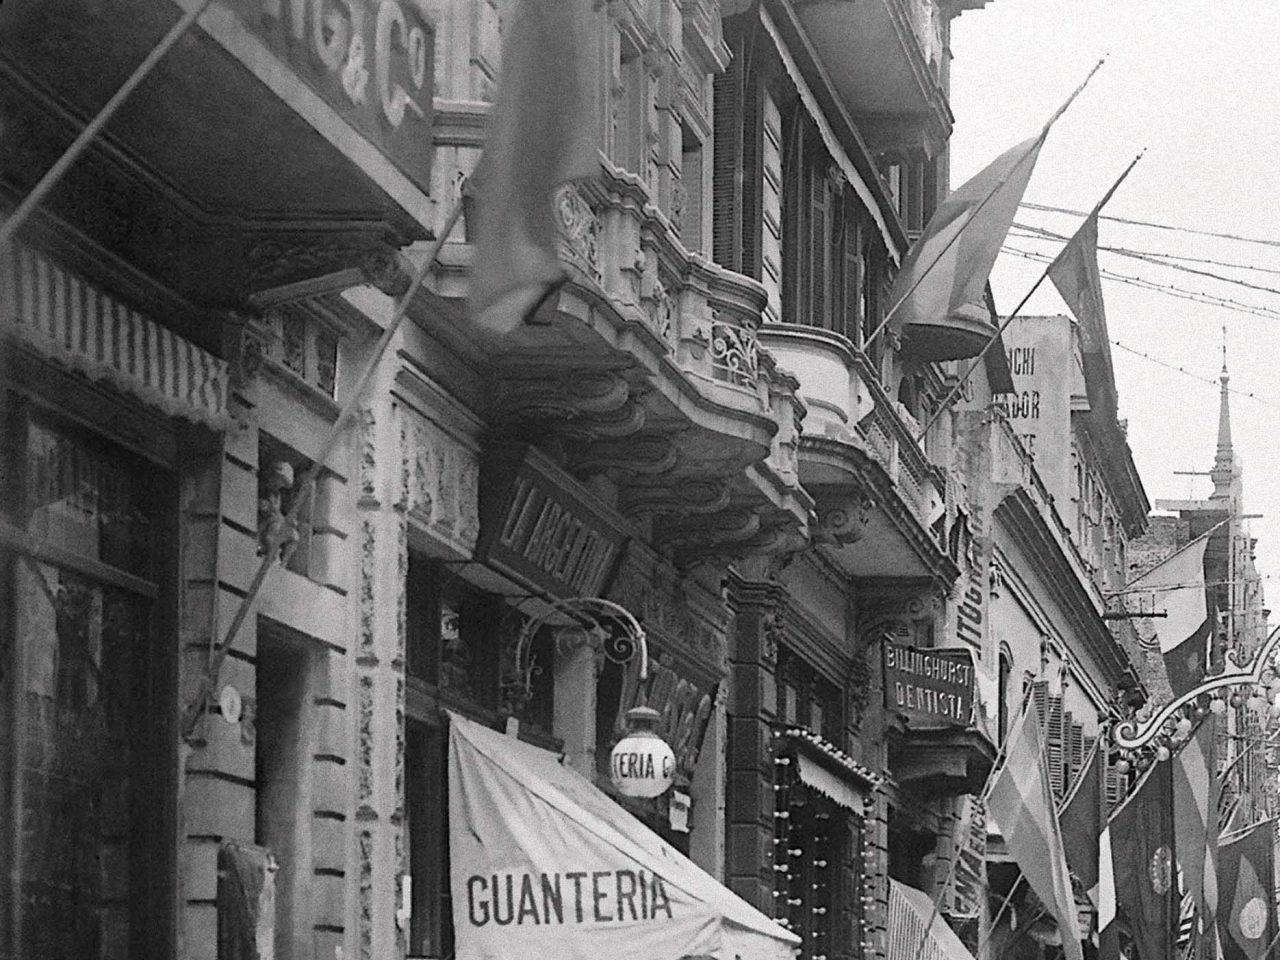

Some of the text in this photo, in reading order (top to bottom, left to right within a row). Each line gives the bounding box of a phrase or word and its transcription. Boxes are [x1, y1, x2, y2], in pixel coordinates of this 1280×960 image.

[886, 645, 970, 687] BILLINGHURST
[895, 681, 964, 719] DENTISTA
[467, 869, 673, 927] GUANTERIA
